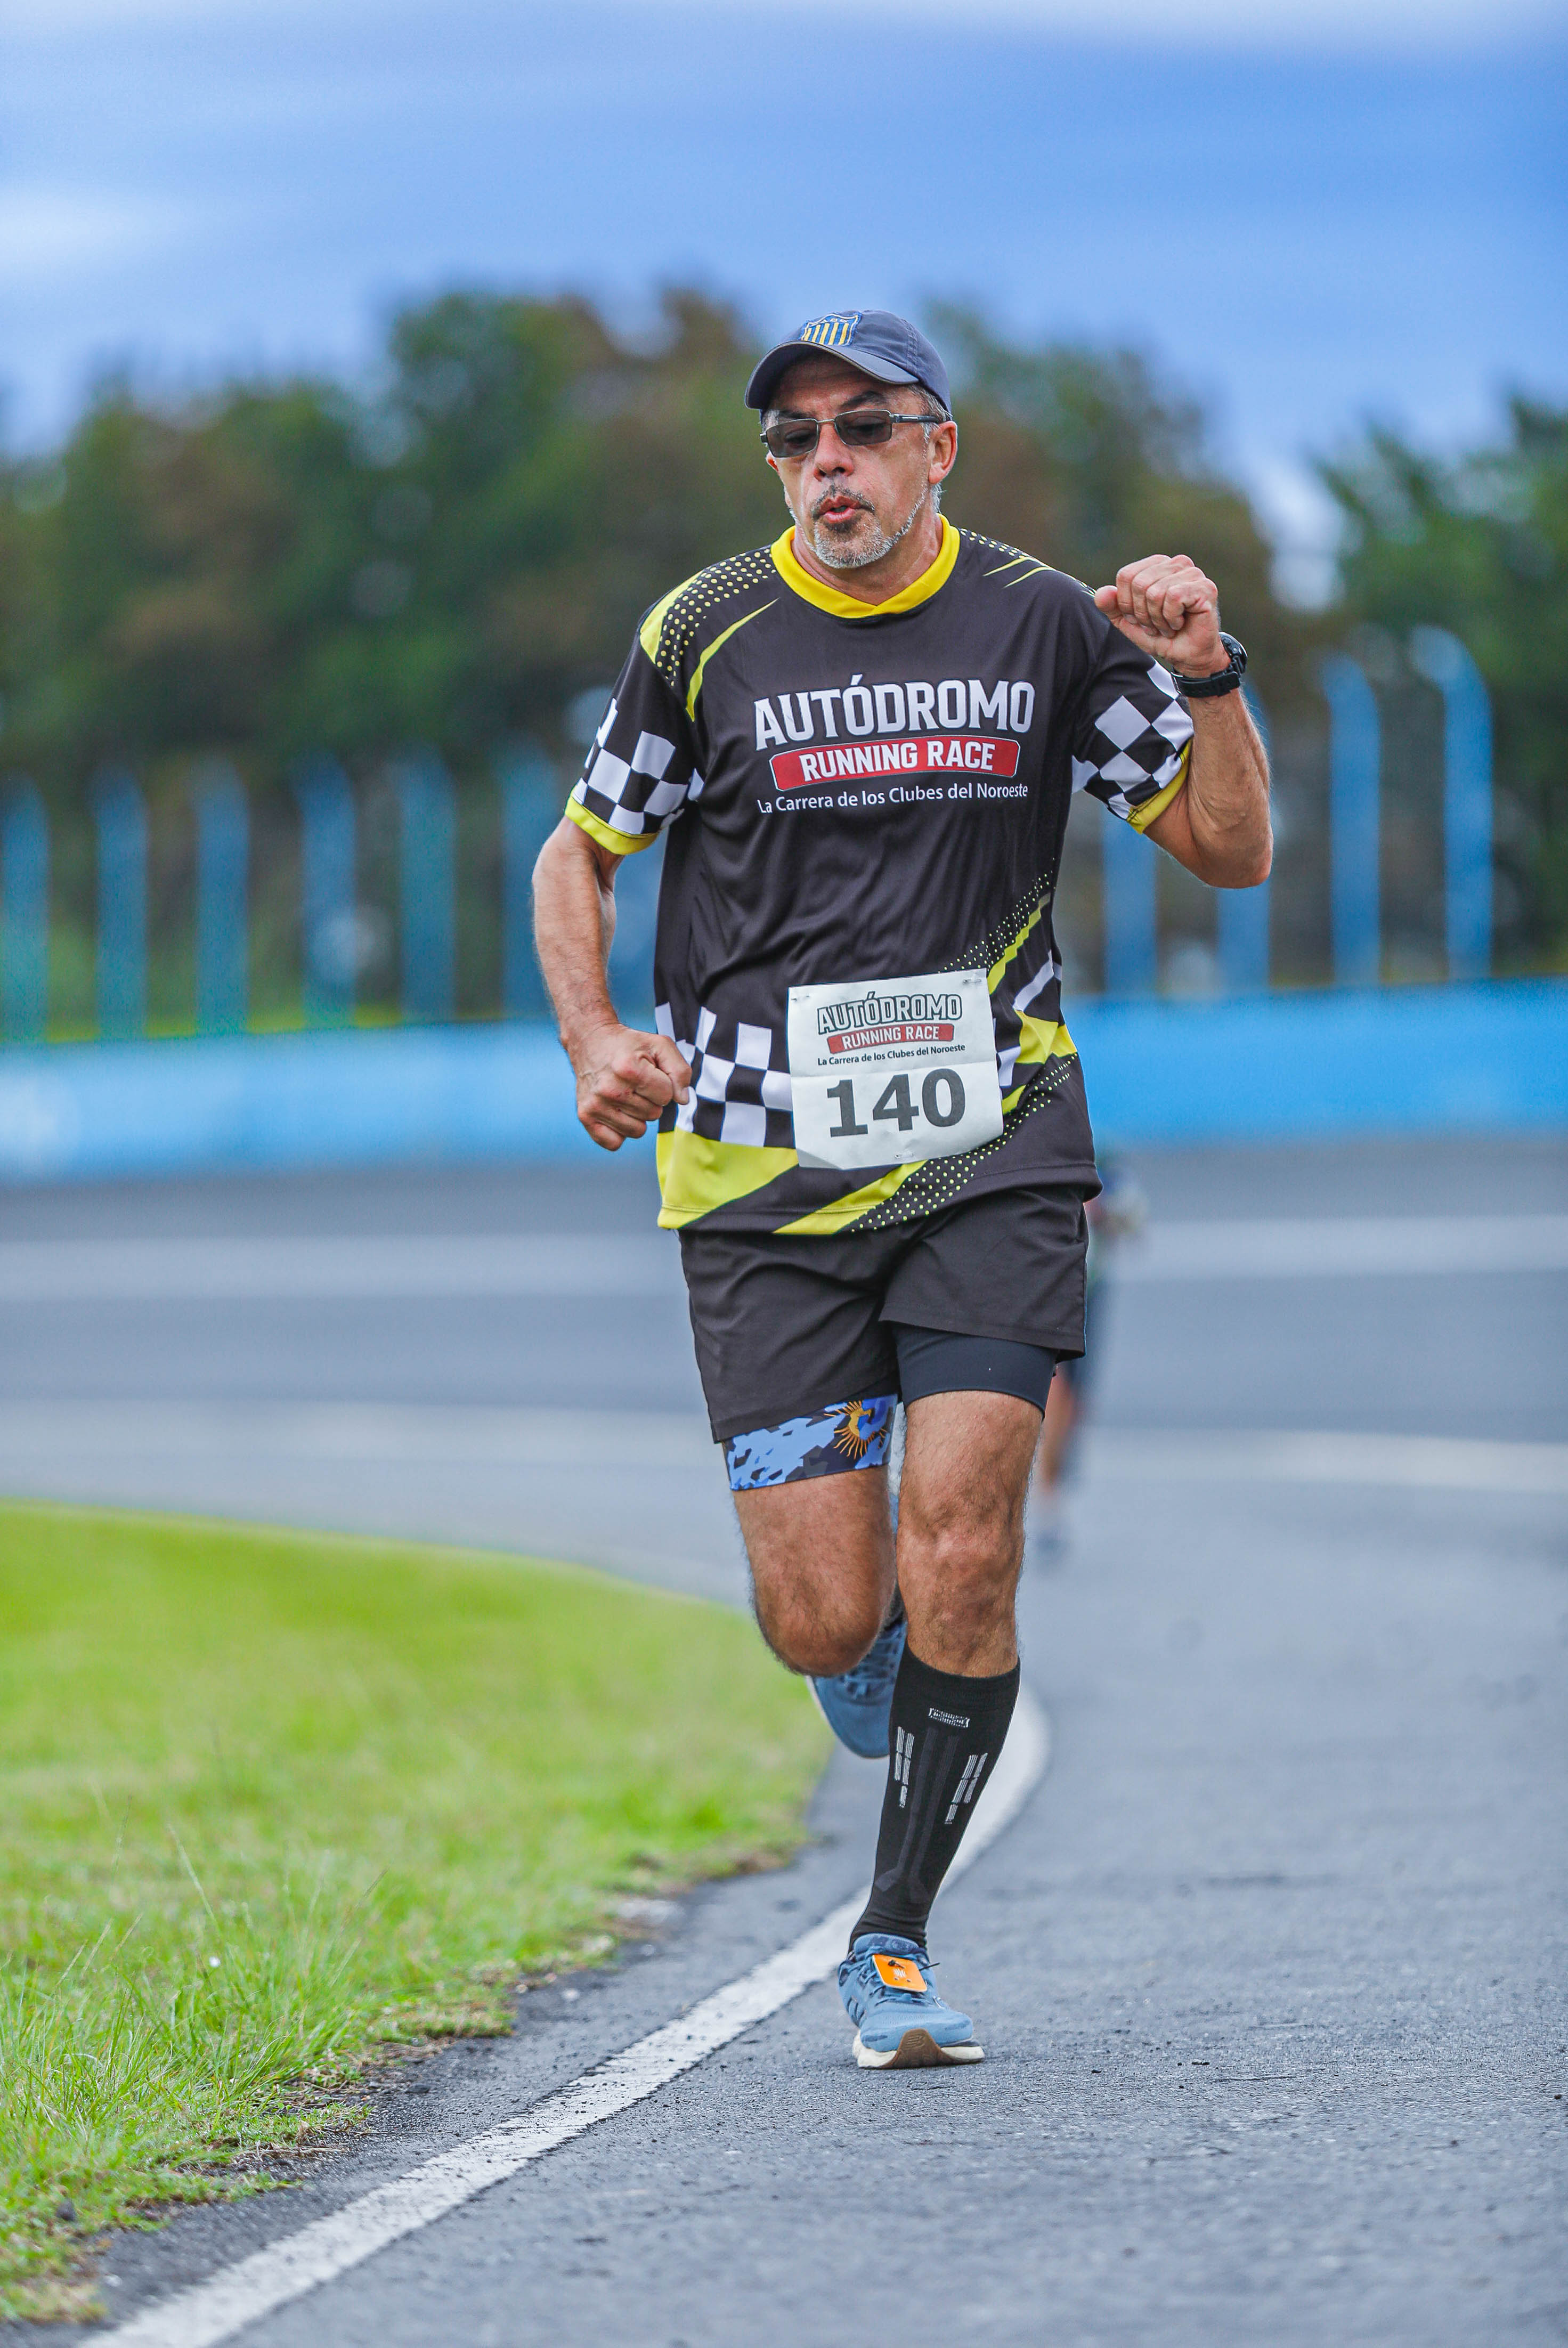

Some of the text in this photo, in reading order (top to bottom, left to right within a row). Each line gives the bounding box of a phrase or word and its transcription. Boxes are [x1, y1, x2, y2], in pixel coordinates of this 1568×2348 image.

[754, 673, 1035, 751] AUTÓDROMO
[799, 741, 995, 782] RUNNING RACE
[758, 783, 1028, 814] La Carrera de los Clubes del Noroeste
[817, 991, 962, 1035] AUTÓDROMO
[829, 1055, 859, 1065] Carrera
[862, 1053, 872, 1062] de
[874, 1052, 885, 1061] los
[888, 1050, 914, 1059] Clubes
[916, 1047, 929, 1055] del
[931, 1044, 965, 1054] Noroeste
[842, 1026, 939, 1050] RUNNING RACE
[827, 1068, 965, 1137] 140
